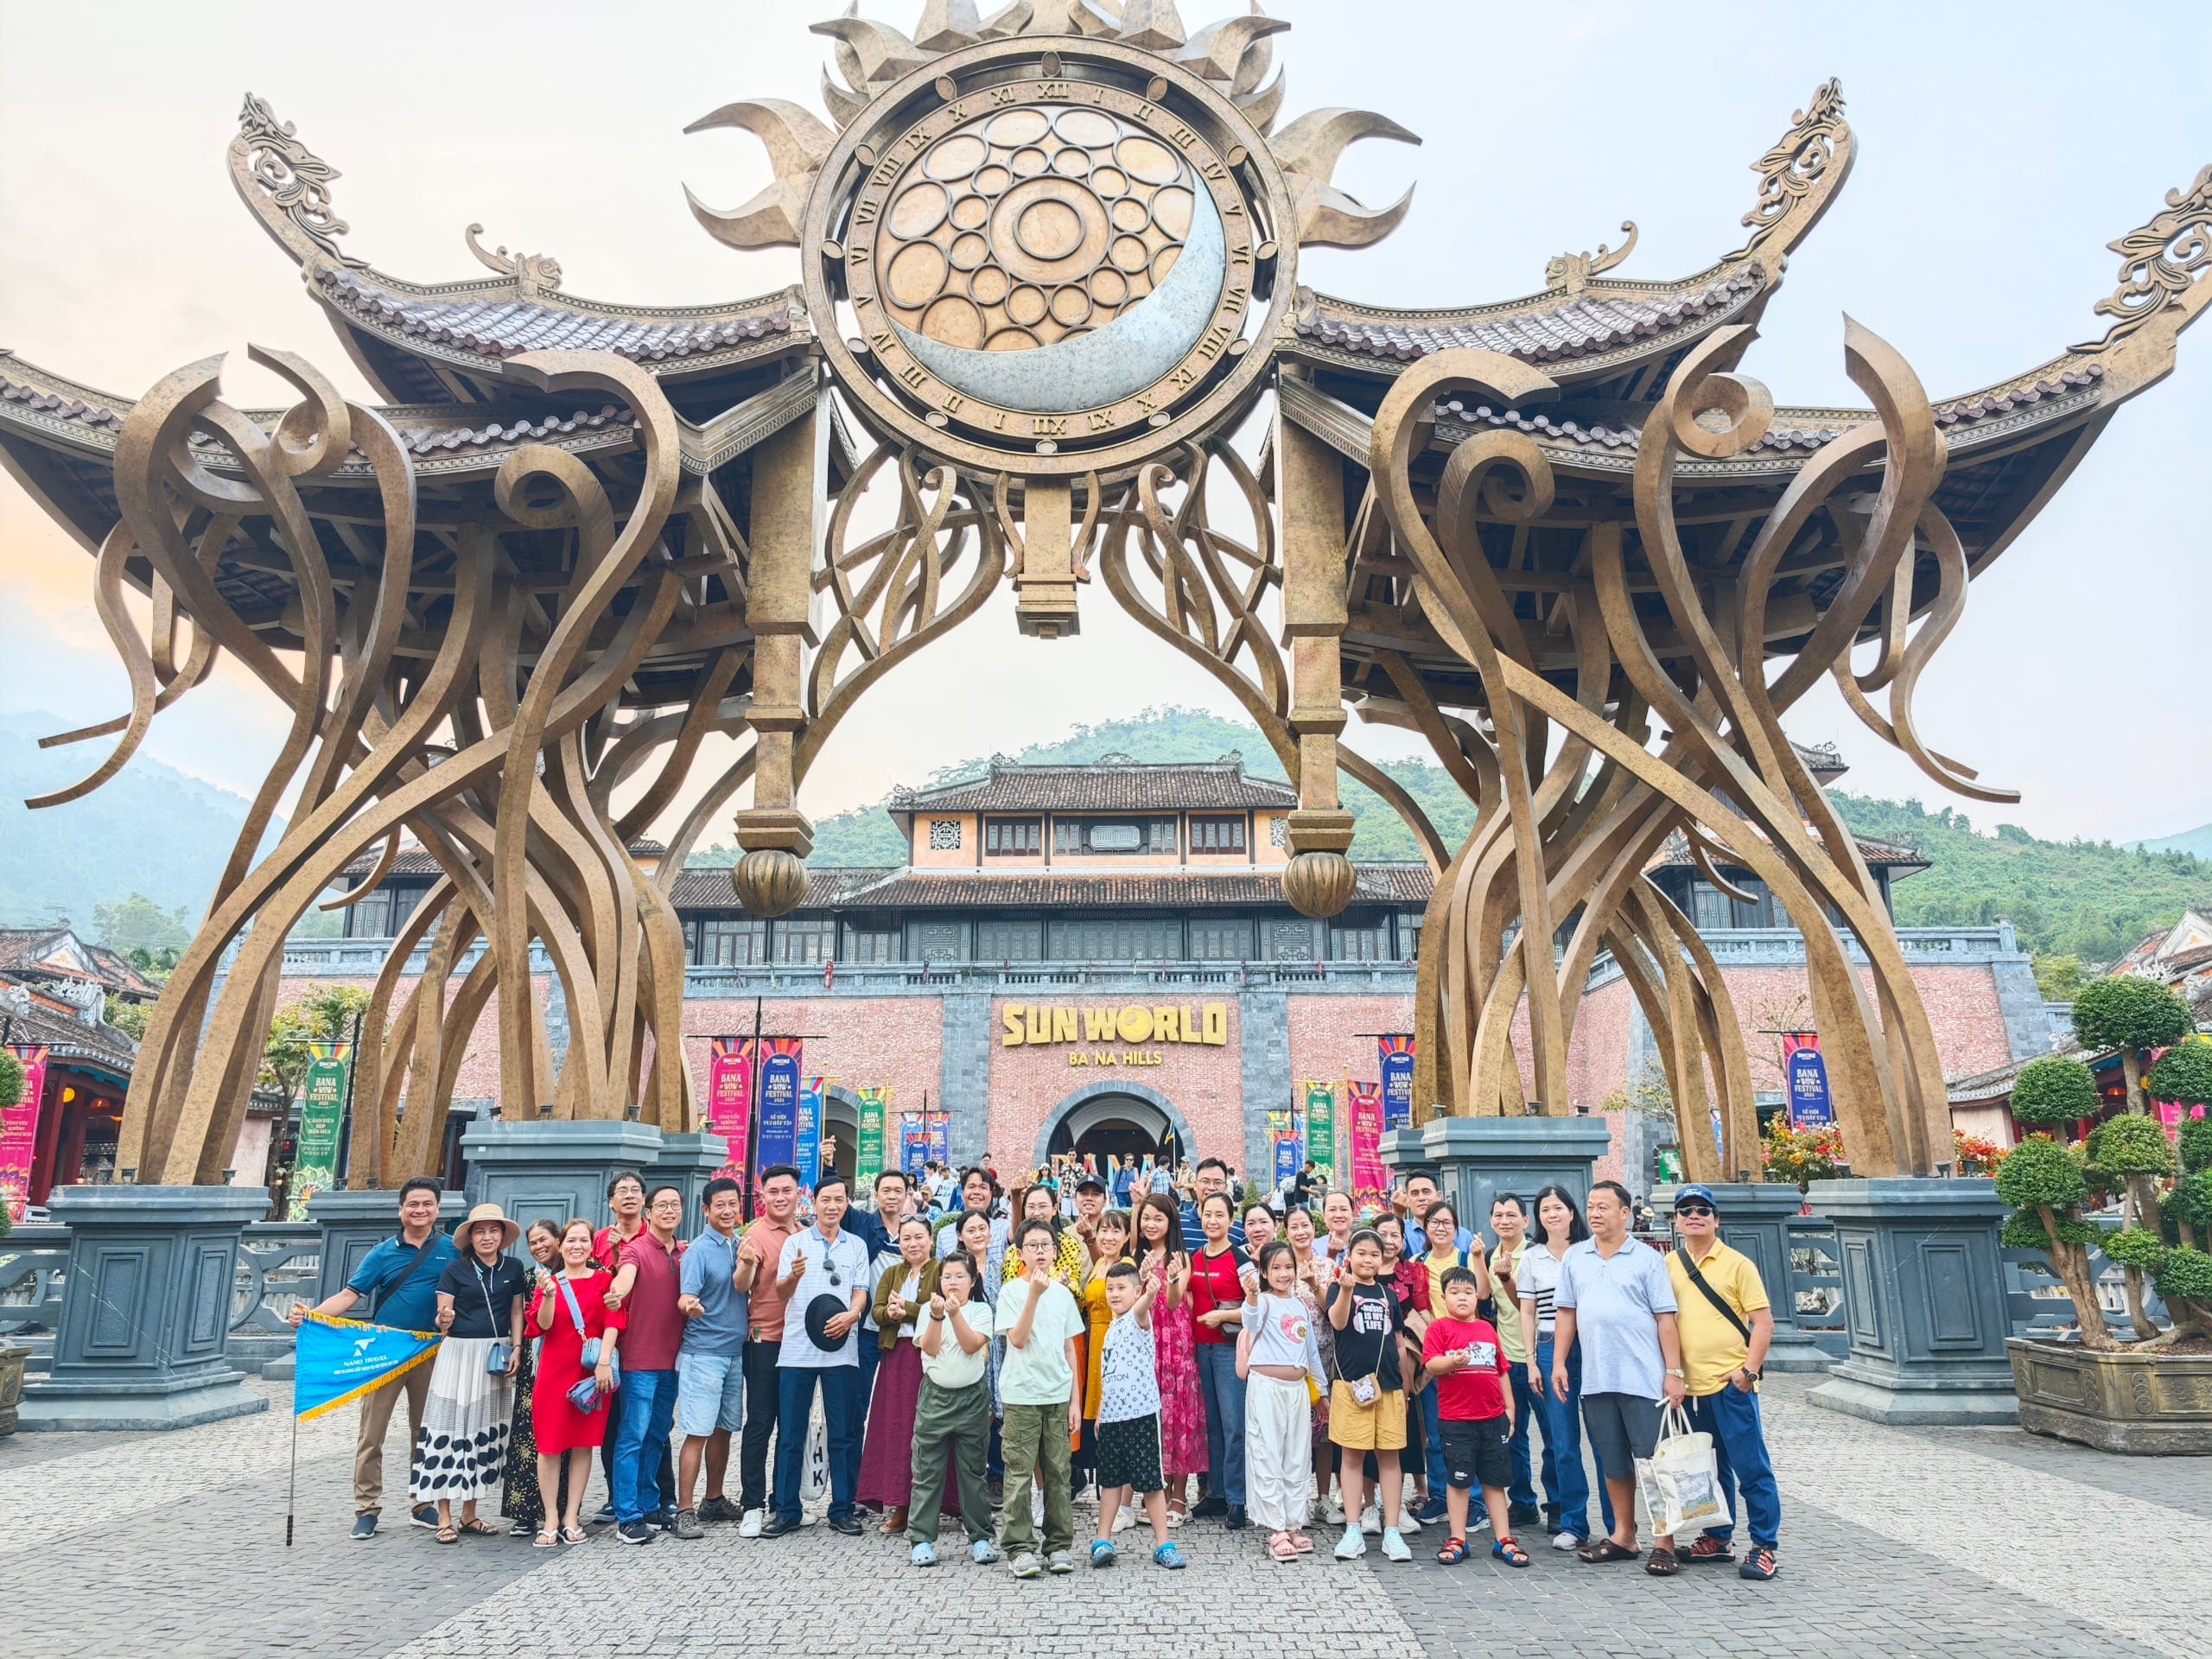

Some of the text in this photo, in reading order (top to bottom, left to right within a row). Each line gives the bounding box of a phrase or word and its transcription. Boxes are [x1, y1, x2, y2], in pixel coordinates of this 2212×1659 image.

[991, 87, 1016, 105] XI
[1038, 84, 1070, 99] XII
[1093, 88, 1103, 103] I
[949, 103, 967, 122] X
[1133, 103, 1154, 121] II
[906, 127, 931, 150] IX
[1169, 124, 1196, 149] III
[872, 153, 905, 188] VIII
[1201, 158, 1226, 180] IV
[855, 198, 880, 226] VII
[1224, 200, 1243, 215] V
[851, 242, 868, 265] VI
[1232, 245, 1249, 264] VI
[855, 291, 874, 308] V
[1224, 286, 1246, 314] VII
[870, 329, 896, 353] IV
[1198, 326, 1230, 360] VIII
[899, 362, 927, 388] III
[1171, 365, 1198, 390] IX
[942, 393, 963, 413] II
[1137, 393, 1158, 413] X
[994, 413, 1005, 429] I
[1033, 417, 1066, 435] XII
[1088, 410, 1114, 430] XI
[1002, 1002, 1227, 1046] SUN WORLD
[1069, 1051, 1162, 1065] BA NA HILLS
[315, 1077, 336, 1086] BANA
[721, 1073, 741, 1083] BANA
[770, 1074, 790, 1084] BANA
[1390, 1072, 1411, 1082] BANA
[1796, 1069, 1818, 1078] BANA
[1358, 1112, 1376, 1121] BANA
[1364, 1319, 1382, 1331] LIFE
[343, 1355, 388, 1367] NANO TRAVEL
[813, 1446, 823, 1464] H
[813, 1470, 823, 1487] K
